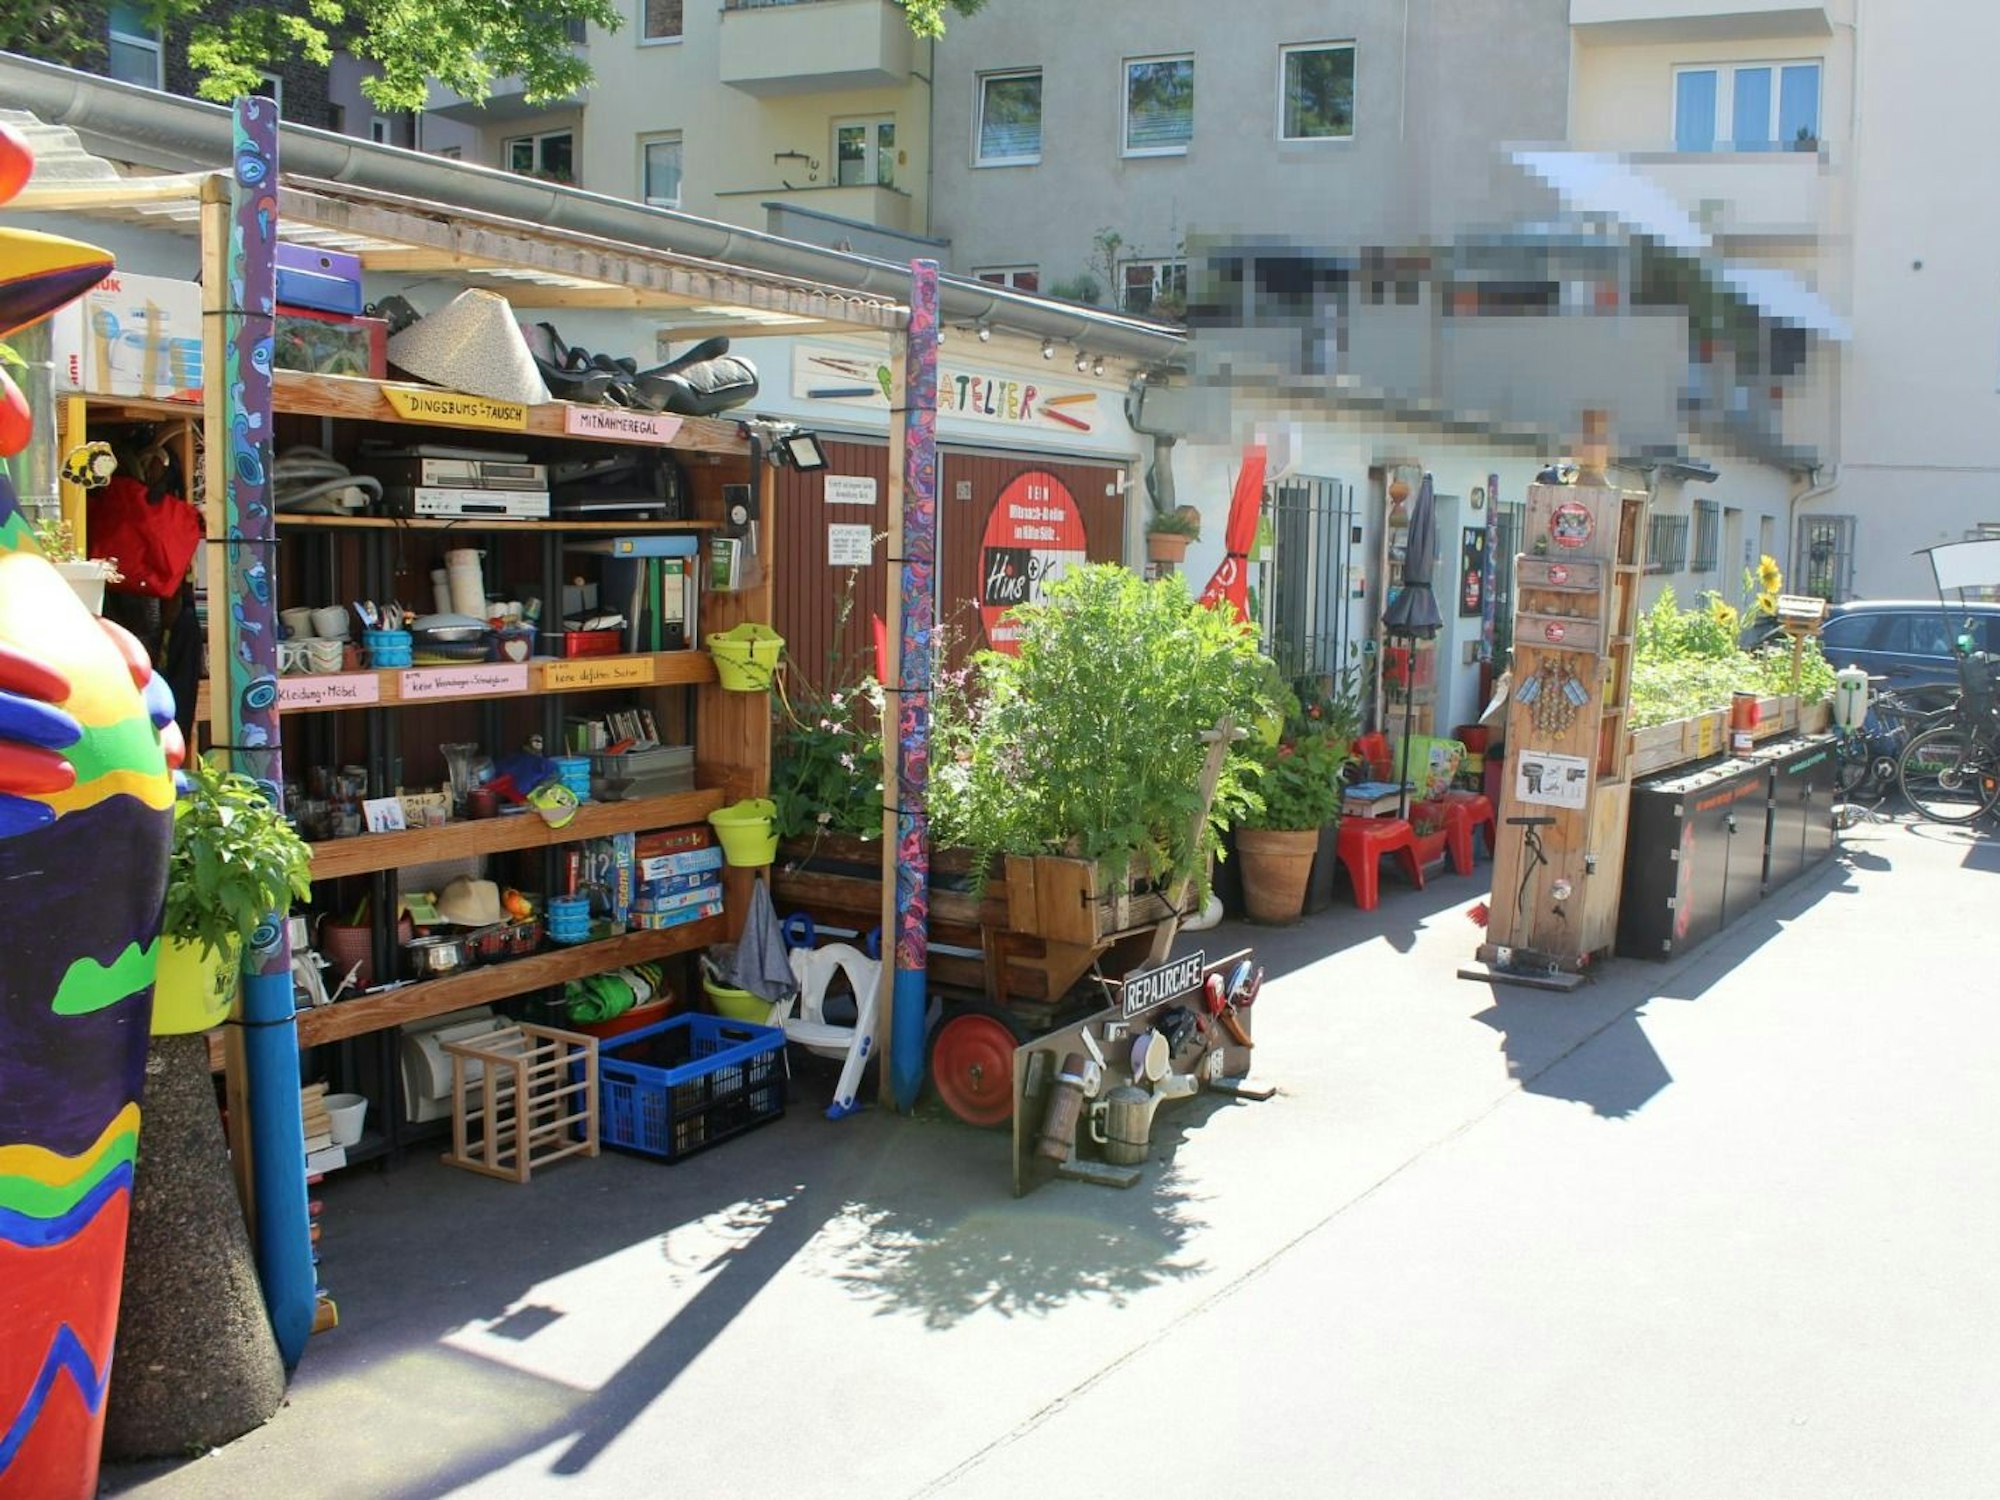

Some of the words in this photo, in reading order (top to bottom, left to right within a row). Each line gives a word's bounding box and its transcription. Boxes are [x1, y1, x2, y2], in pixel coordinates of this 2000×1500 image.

[938, 373, 1038, 421] ATELIER
[985, 551, 1028, 602] Hins
[584, 850, 611, 886] it?
[1127, 956, 1202, 1013] REPAIRCAFE
